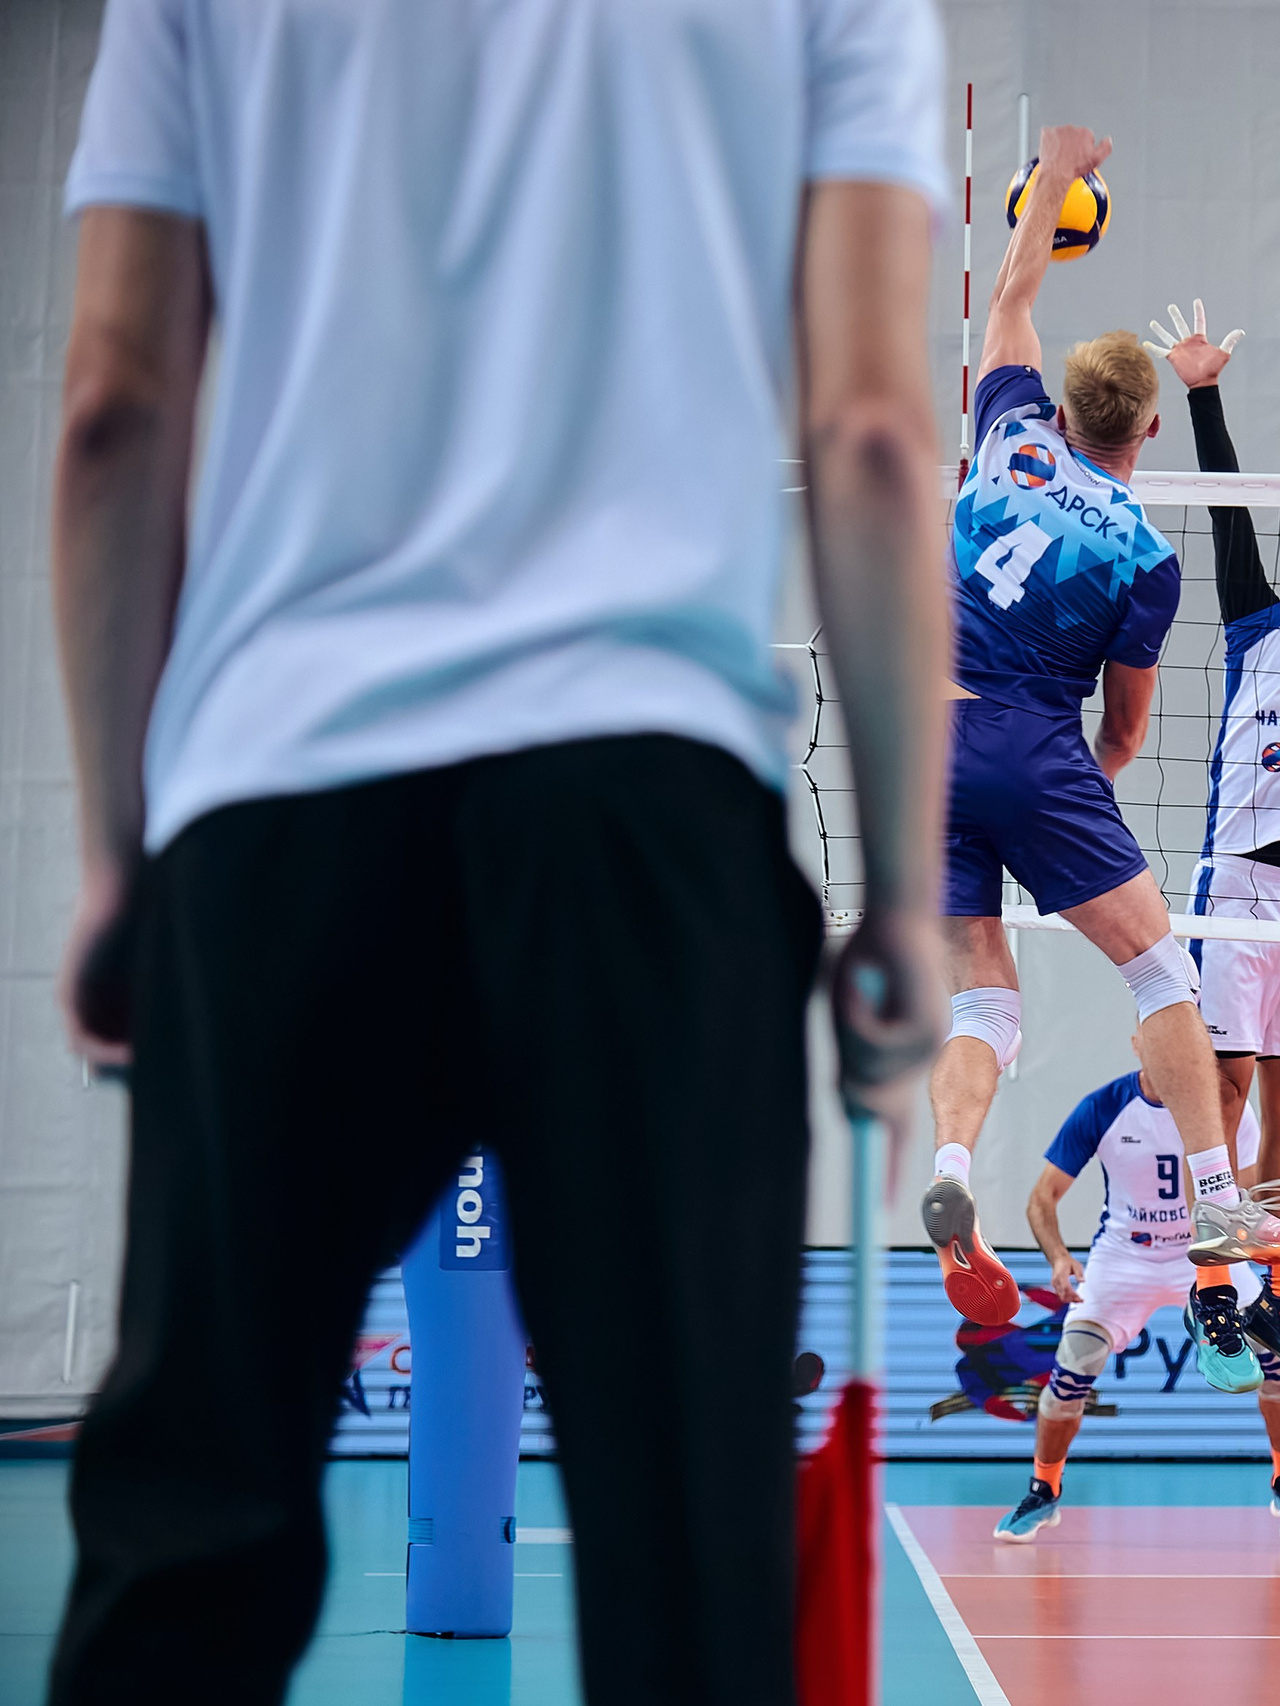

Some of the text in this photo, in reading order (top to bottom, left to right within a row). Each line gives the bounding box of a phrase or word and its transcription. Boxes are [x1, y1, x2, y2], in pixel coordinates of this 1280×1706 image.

[1045, 486, 1119, 540] ДРСК
[974, 520, 1053, 611] 4
[1156, 1154, 1179, 1200] 9
[456, 1156, 491, 1258] noh
[1127, 1204, 1187, 1222] АЙКОВС
